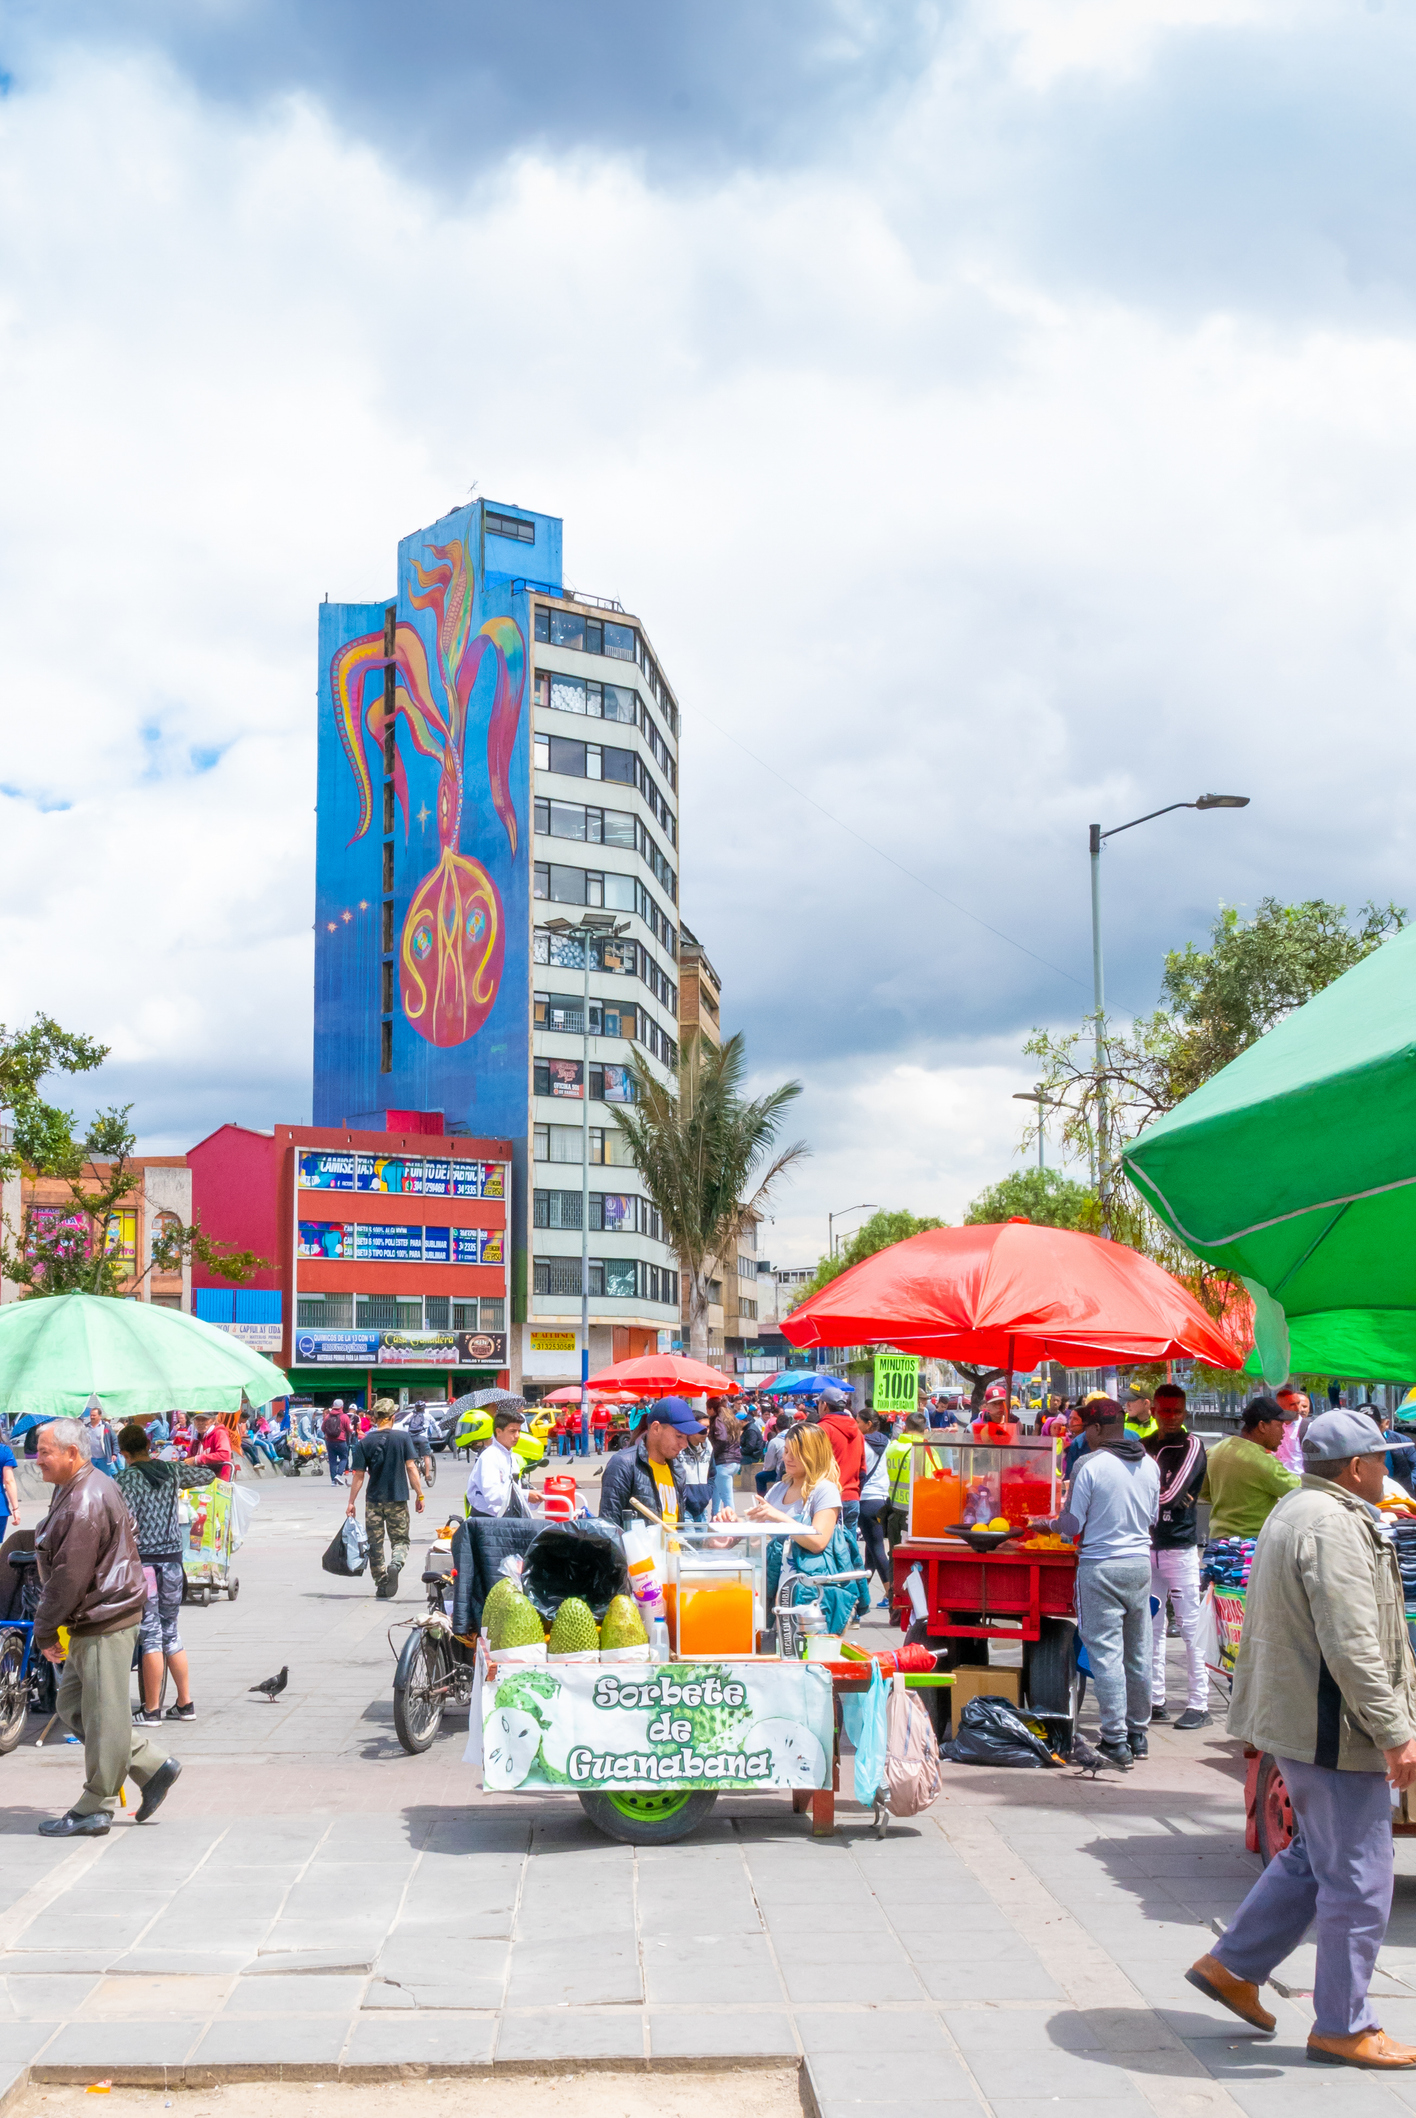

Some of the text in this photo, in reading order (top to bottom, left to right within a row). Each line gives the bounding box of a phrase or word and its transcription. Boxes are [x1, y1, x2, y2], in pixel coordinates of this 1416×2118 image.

[385, 1333, 407, 1346] Casa
[880, 1359, 915, 1371] MINUTOS
[878, 1400, 889, 1409] TODO
[594, 1675, 746, 1708] Sorbete
[648, 1711, 693, 1744] de
[567, 1746, 772, 1782] Guanabana
